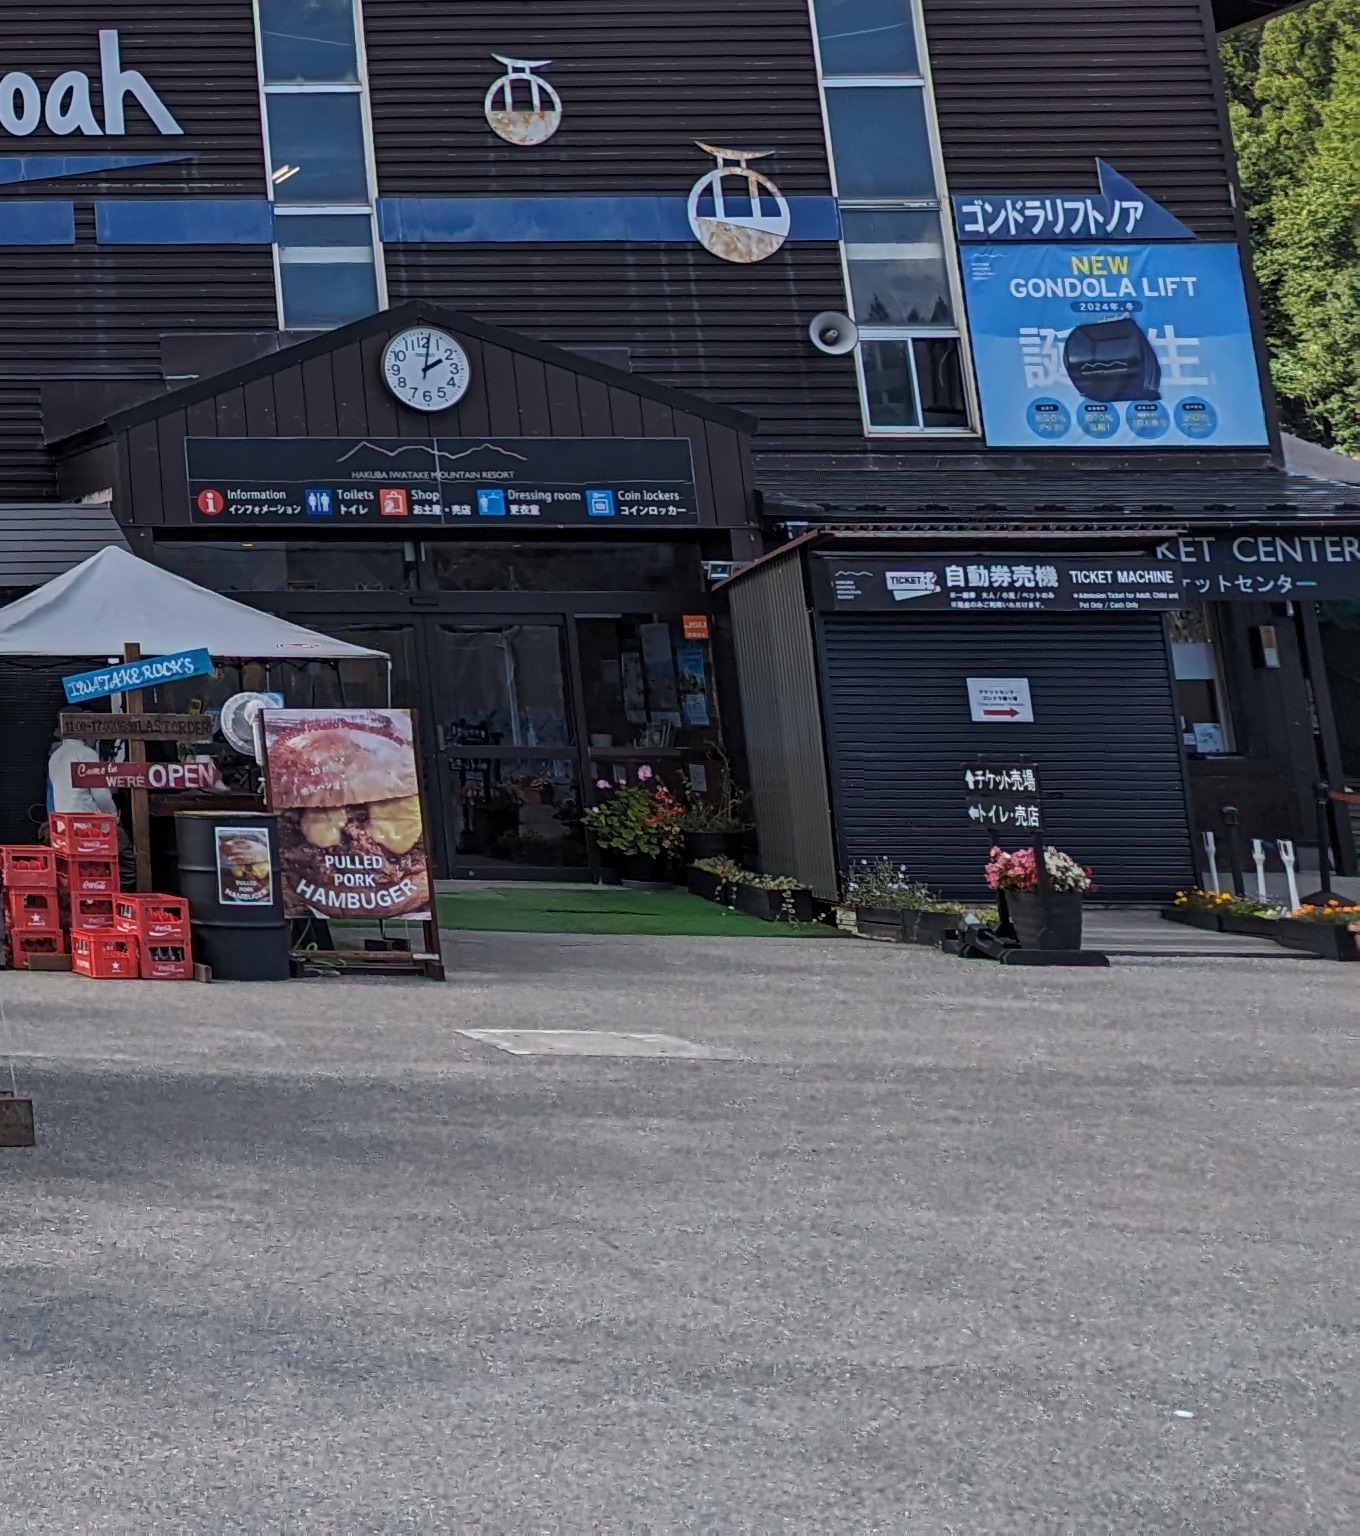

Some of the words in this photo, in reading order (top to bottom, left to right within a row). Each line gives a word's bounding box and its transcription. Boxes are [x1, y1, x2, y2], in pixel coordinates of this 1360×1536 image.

[1071, 255, 1129, 275] NEW
[1010, 277, 1137, 298] GONDOLA
[1143, 276, 1197, 297] LIFT
[393, 350, 406, 362] 10
[444, 348, 454, 360] 2
[391, 364, 400, 376] 9
[449, 363, 459, 375] 3
[397, 376, 407, 388] 8
[446, 377, 456, 387] 4
[409, 387, 418, 398] 7
[422, 390, 432, 402] 6
[437, 387, 446, 398] 5
[431, 471, 480, 479] MOUNTAIN
[482, 471, 514, 479] RESORT
[227, 489, 286, 500] Information
[336, 489, 374, 500] Toilets
[411, 489, 440, 503] Shop
[507, 490, 551, 501] Dressing
[553, 491, 581, 500] room
[617, 490, 641, 500] Coin
[643, 490, 679, 500] lockers
[340, 505, 368, 514] トイレ
[1233, 536, 1360, 562] CENTER
[890, 576, 921, 585] TICKET
[945, 565, 1058, 587] 自動券売機
[1069, 570, 1112, 584] TICKET
[1117, 570, 1174, 584] MACHINE
[78, 764, 105, 777] Come
[148, 764, 214, 788] OPEN
[974, 769, 1036, 791] チケット売場
[979, 804, 1040, 827] トイレ・売店
[325, 855, 382, 869] PULLED
[333, 873, 376, 887] PORK
[295, 878, 418, 909] HAMBUGER
